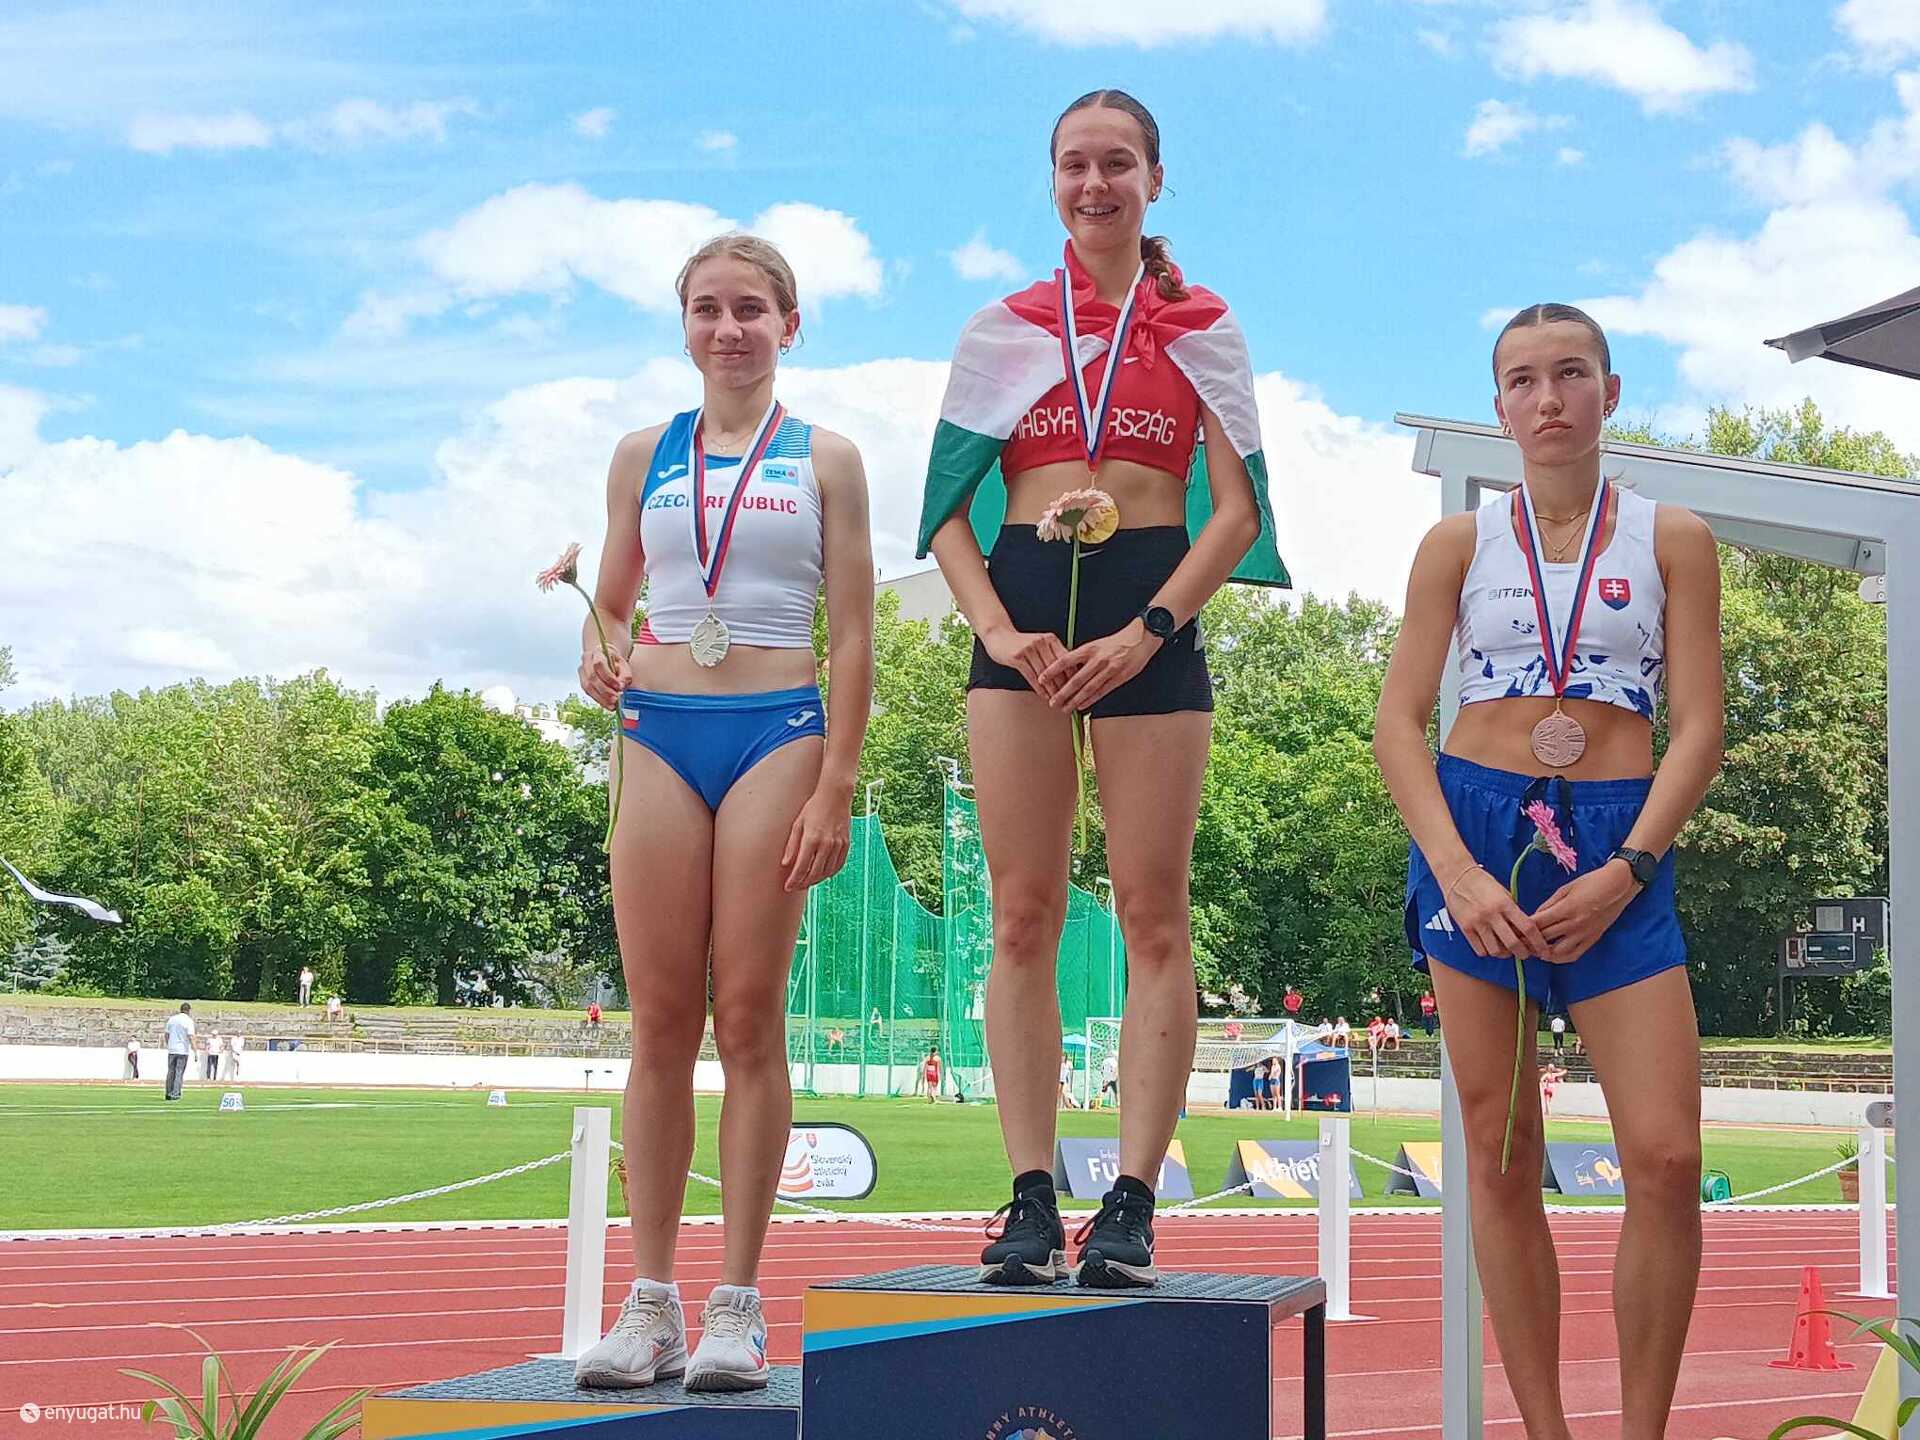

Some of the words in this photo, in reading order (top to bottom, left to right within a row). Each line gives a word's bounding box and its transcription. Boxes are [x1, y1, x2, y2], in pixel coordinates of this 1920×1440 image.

[1011, 406, 1176, 445] AGYARSZÁG
[648, 494, 690, 510] CZEC
[704, 495, 798, 514] REUBLIC
[1018, 1406, 1077, 1440] ATHLET
